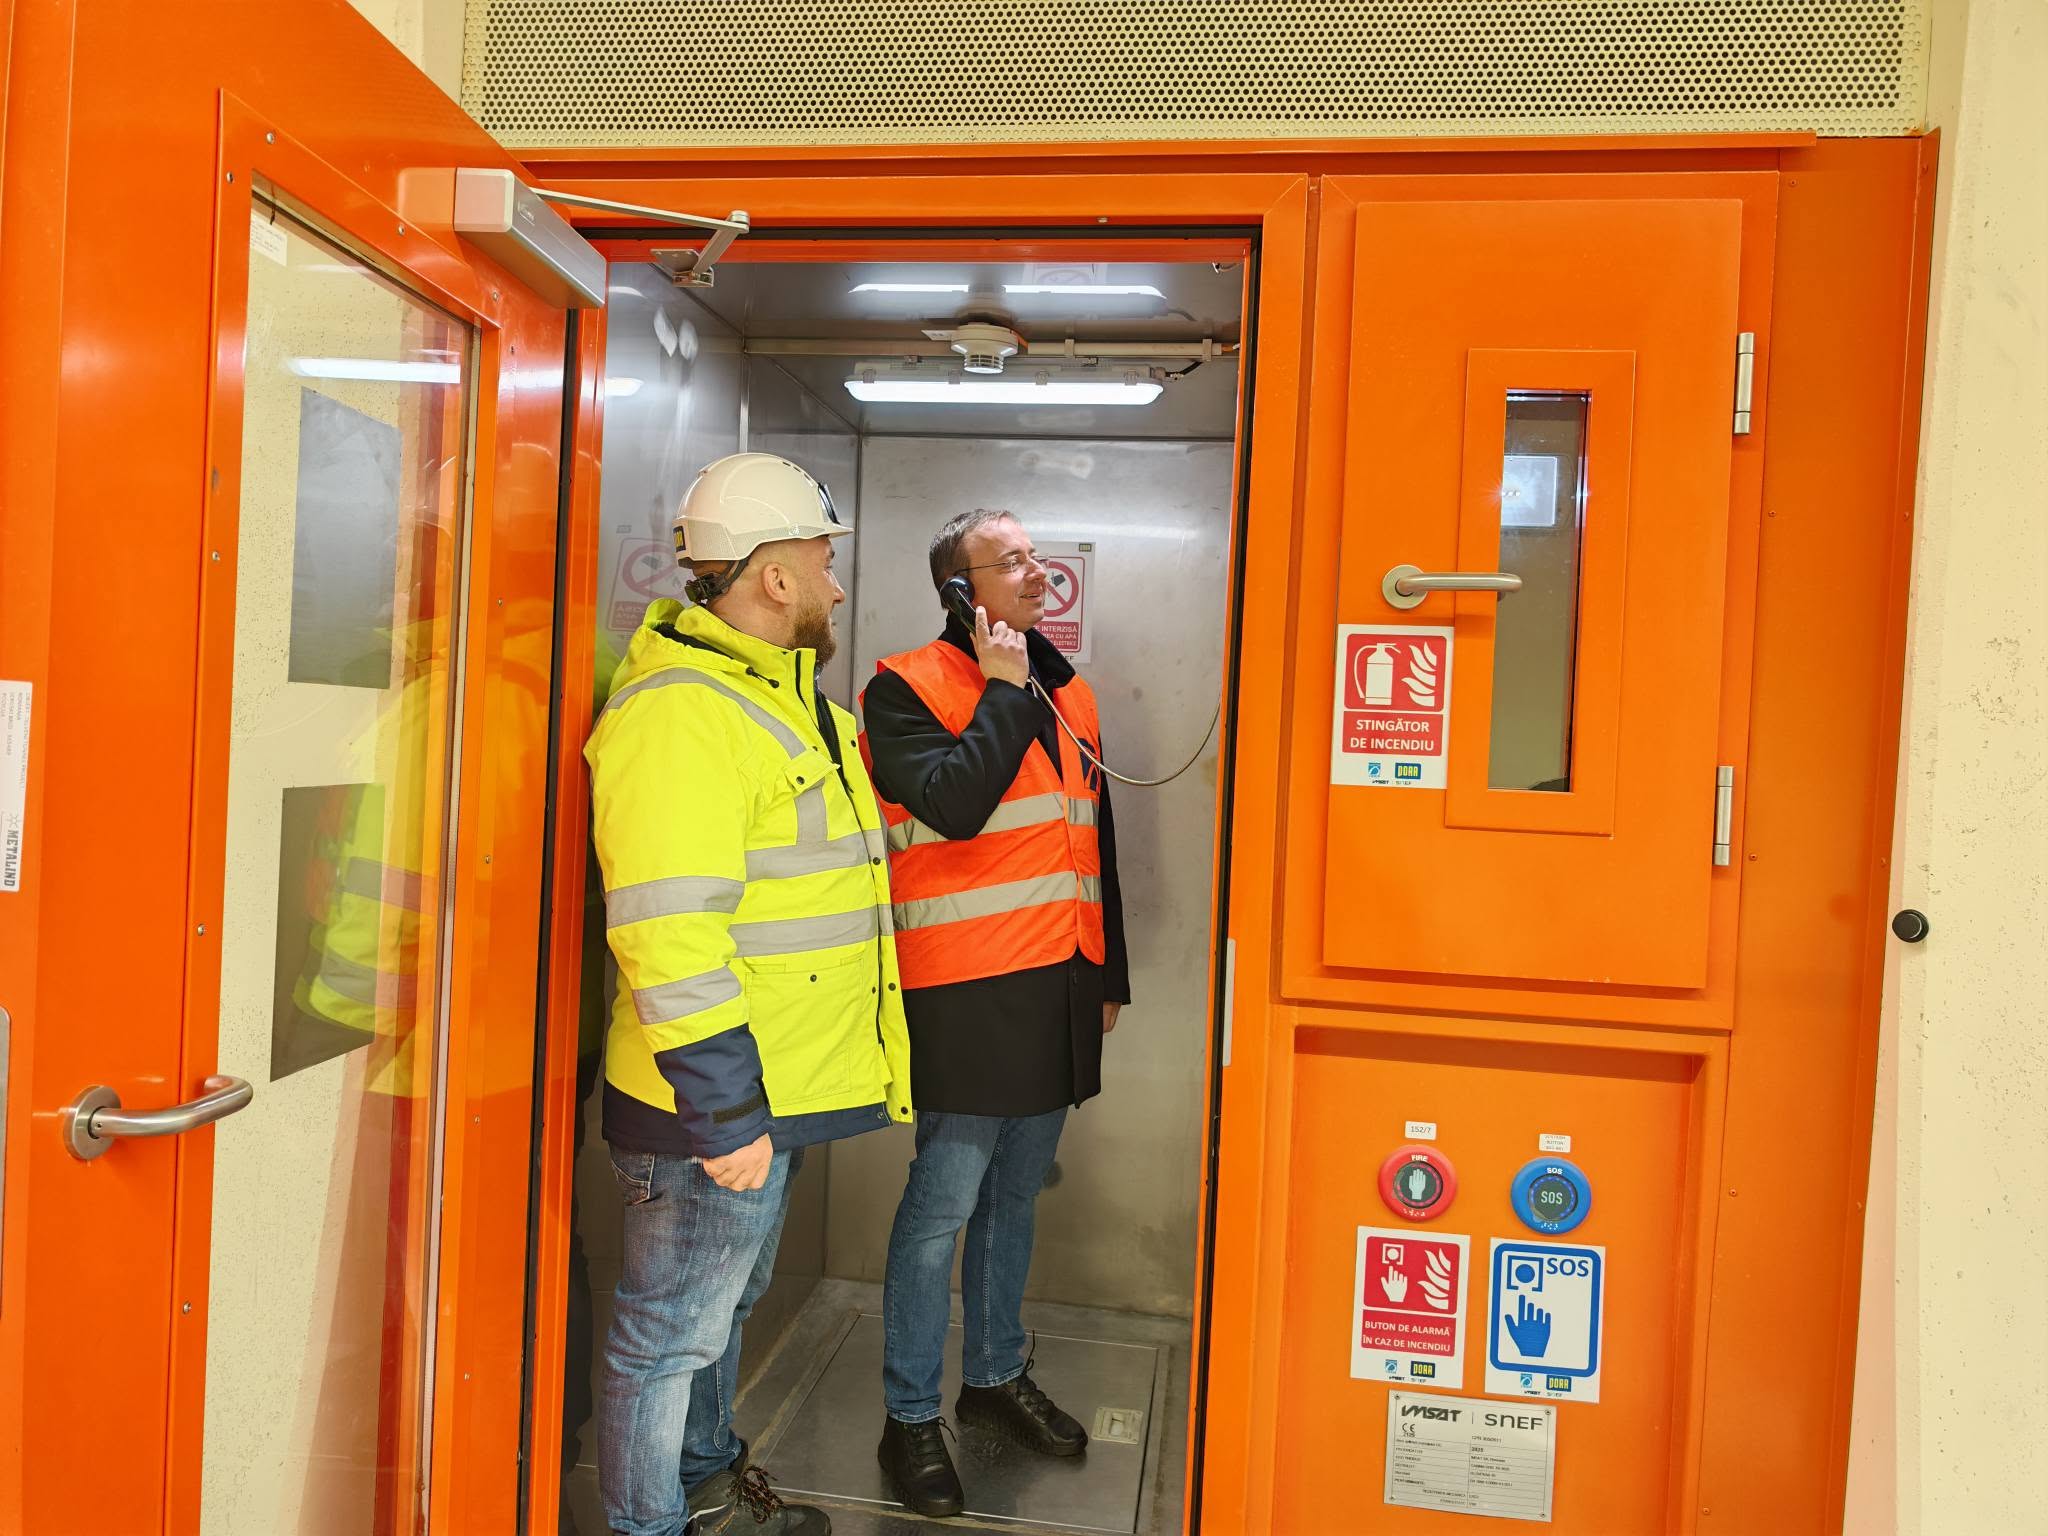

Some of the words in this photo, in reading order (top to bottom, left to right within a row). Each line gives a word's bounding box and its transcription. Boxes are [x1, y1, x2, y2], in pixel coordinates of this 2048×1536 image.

[1356, 718, 1430, 733] STINGĂTOR
[1350, 737, 1367, 748] DE
[1371, 738, 1434, 751] INCENDIU
[4, 830, 19, 887] METALIND
[1411, 1154, 1429, 1162] FIRE
[1547, 1167, 1563, 1175] SOS
[1541, 1190, 1563, 1205] SOS
[1546, 1258, 1589, 1277] SOS
[1364, 1320, 1396, 1331] BUTON
[1398, 1324, 1410, 1333] DE
[1362, 1334, 1373, 1345] ÎN
[1374, 1337, 1391, 1346] CAZ
[1393, 1339, 1405, 1347] DE
[1407, 1341, 1450, 1352] INCENDIU
